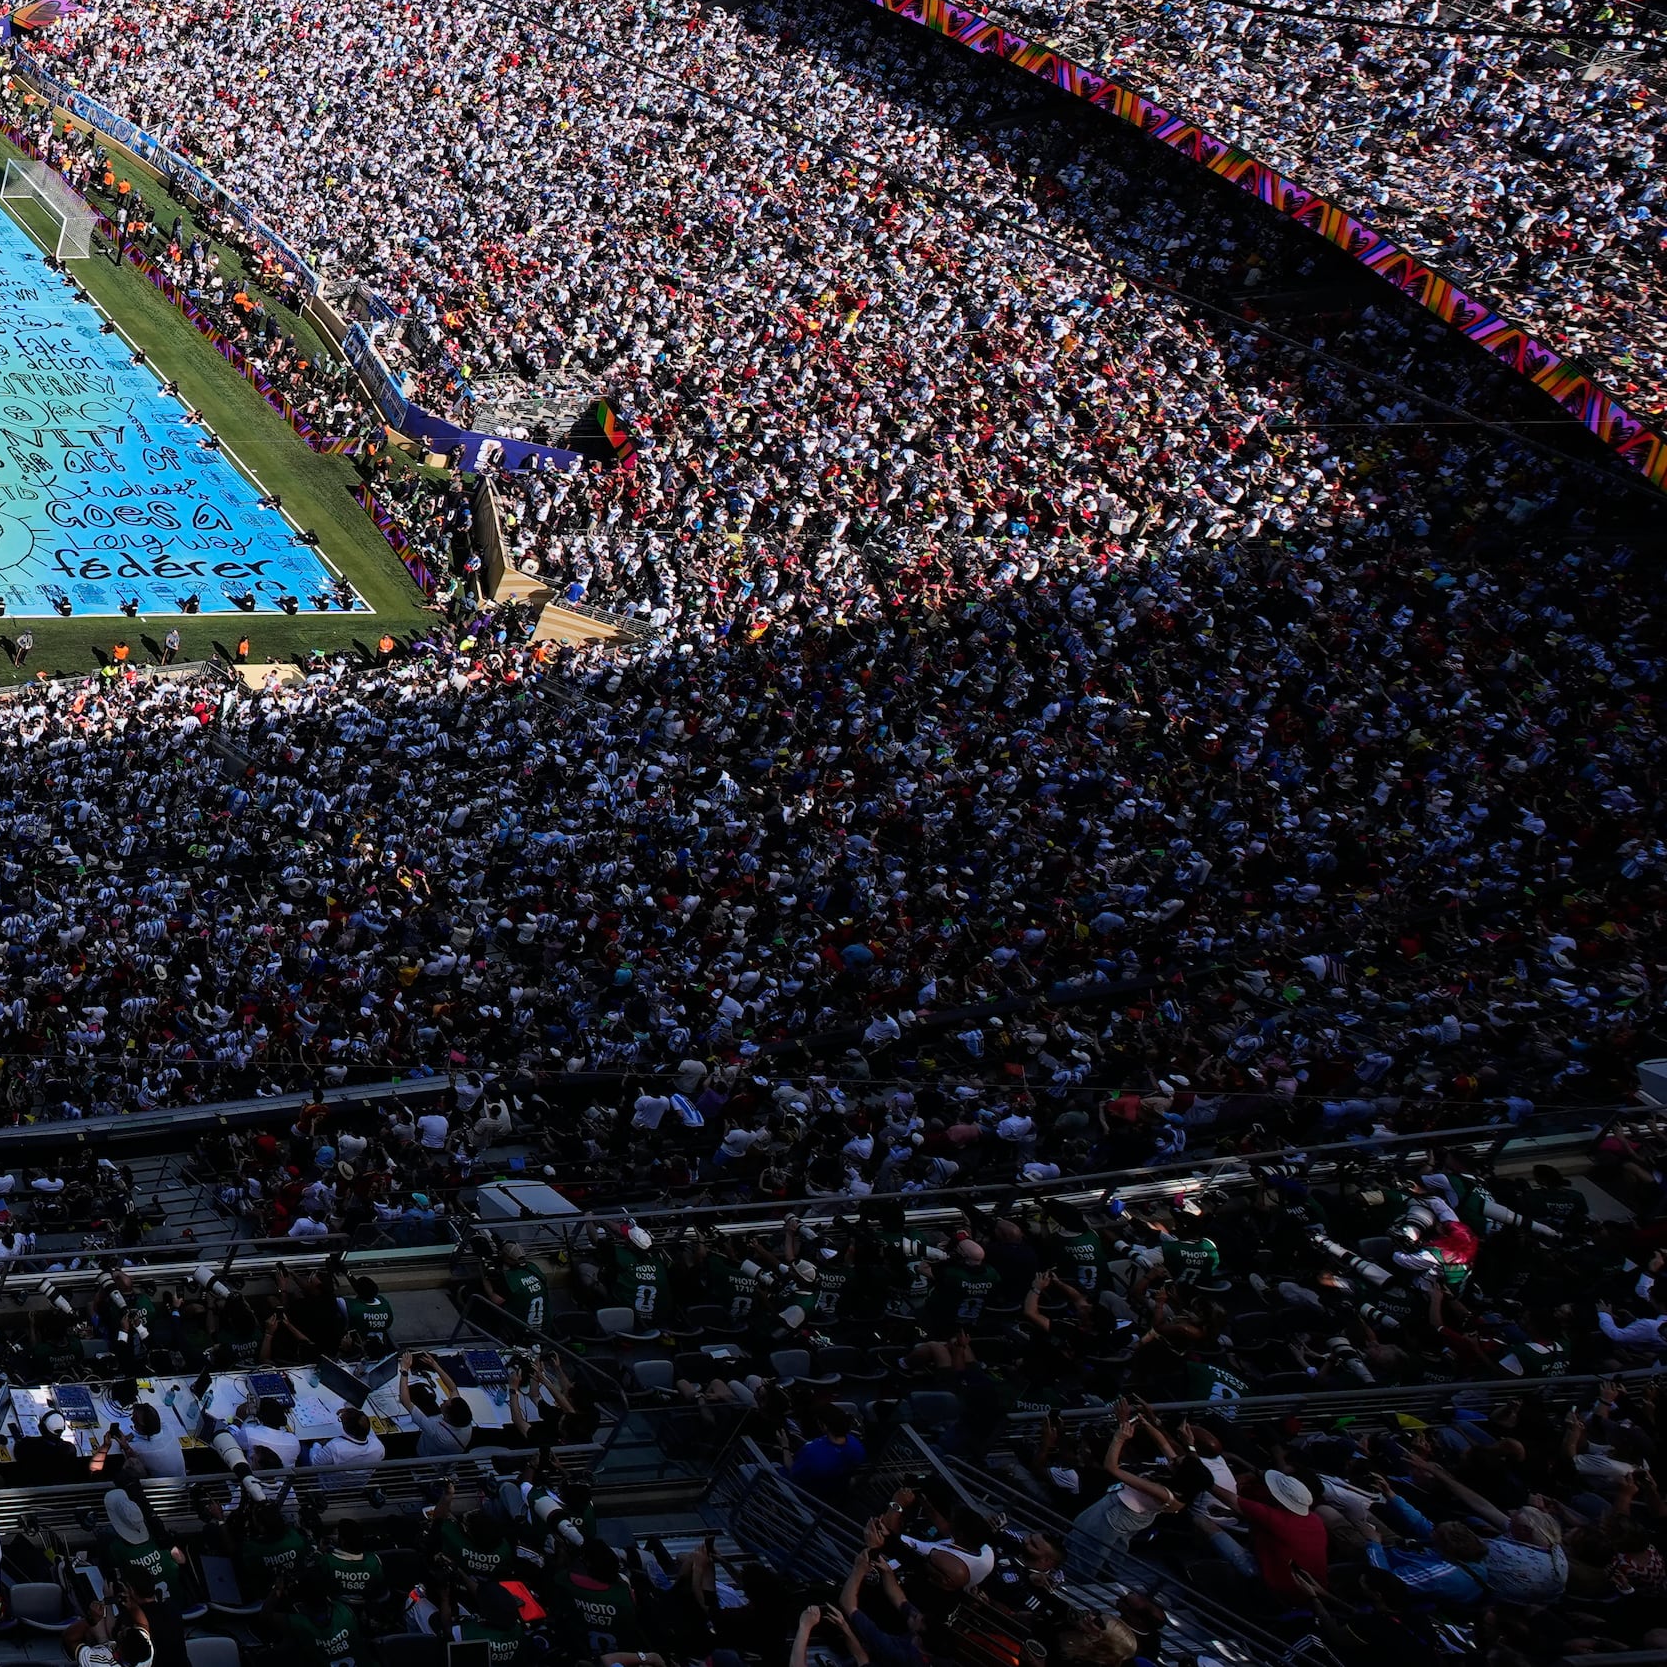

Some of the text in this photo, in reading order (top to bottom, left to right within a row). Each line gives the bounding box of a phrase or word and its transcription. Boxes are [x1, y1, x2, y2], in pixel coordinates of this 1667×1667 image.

[15, 335, 81, 356] take
[26, 354, 104, 372] action
[50, 547, 275, 581] fédérer
[818, 1273, 848, 1283] PHOTO
[962, 1280, 992, 1290] PHOTO
[363, 1312, 390, 1322] PHOTO
[462, 1550, 504, 1564] PHOTO
[335, 1571, 373, 1581] PHOTO
[575, 1598, 619, 1616] PHOTO
